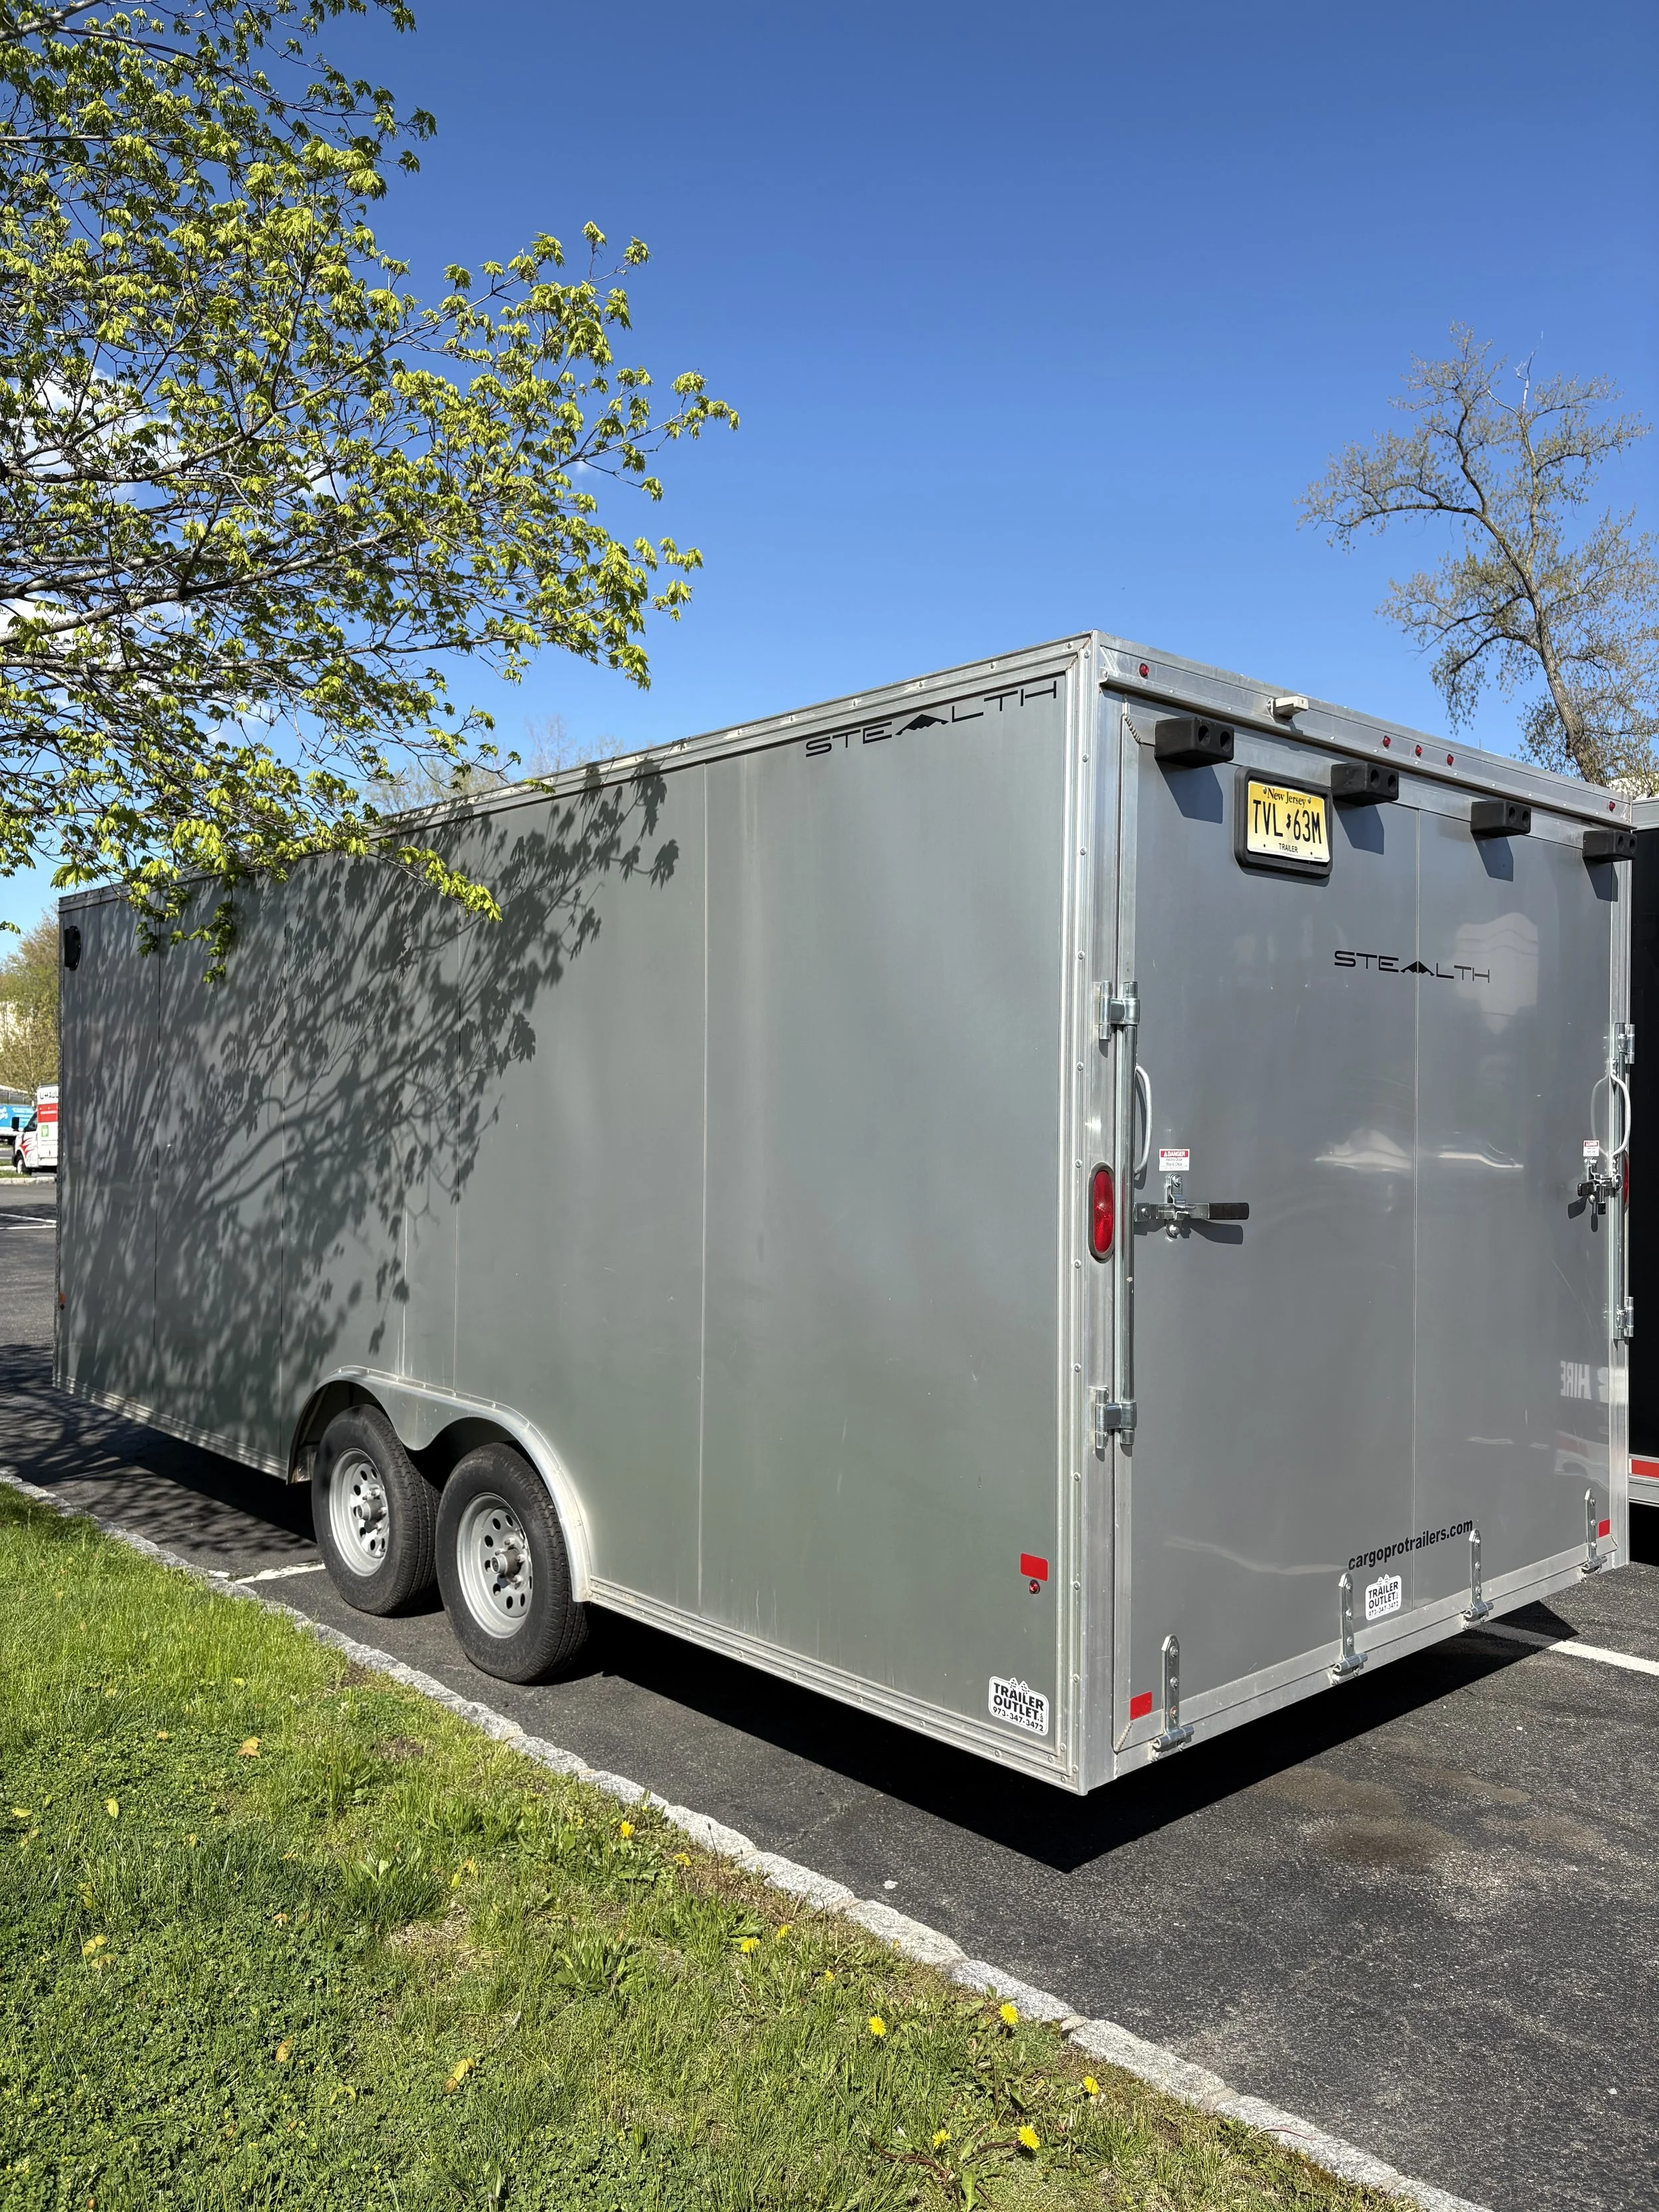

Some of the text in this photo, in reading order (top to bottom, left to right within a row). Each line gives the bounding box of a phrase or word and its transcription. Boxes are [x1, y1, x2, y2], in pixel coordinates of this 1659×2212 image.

[806, 680, 1056, 757] STEALTH
[1267, 788, 1306, 808] New Jersey
[1253, 800, 1322, 844] TVL 63M
[1279, 843, 1298, 853] TRAILER
[1334, 950, 1490, 984] STEALTH
[1348, 1520, 1473, 1570] cargoprotrailers.com
[1368, 1581, 1398, 1599] TRAILER
[993, 1682, 1044, 1711] TRAILER
[993, 1706, 1043, 1732] 973-347-3472
